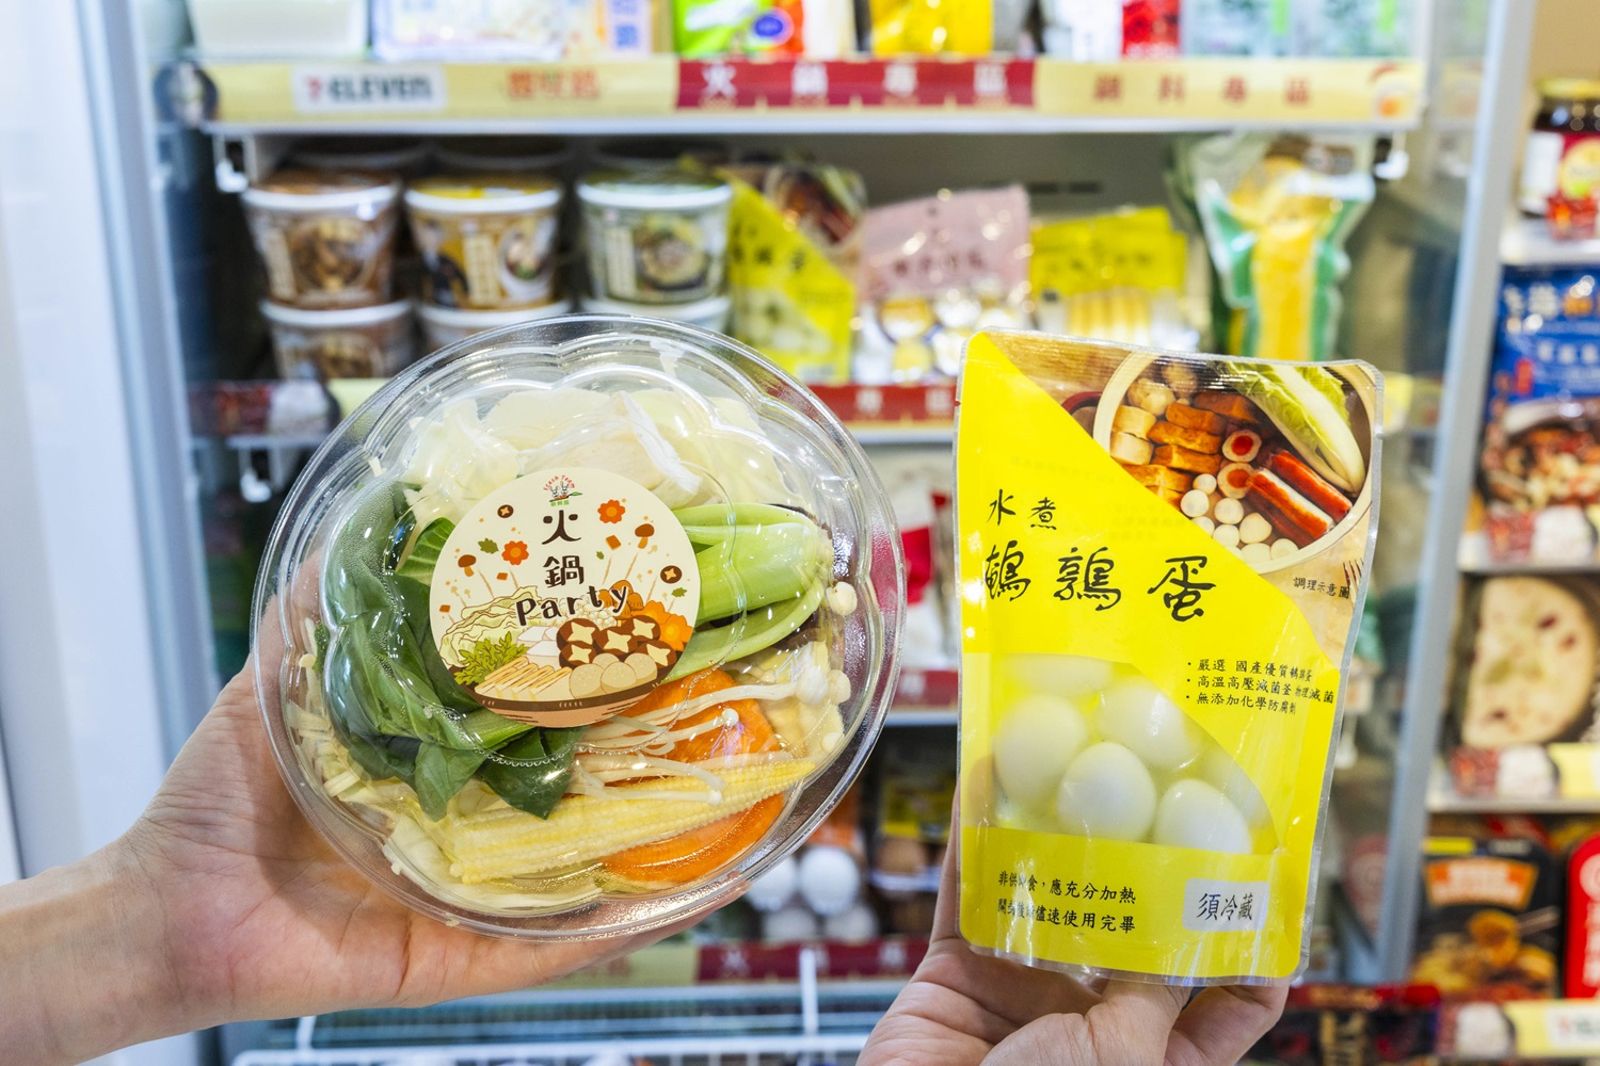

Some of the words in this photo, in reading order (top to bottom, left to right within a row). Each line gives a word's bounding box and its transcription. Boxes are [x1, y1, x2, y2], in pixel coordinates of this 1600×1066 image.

[986, 488, 1058, 531] 水煮
[541, 509, 585, 588] 火鍋
[984, 539, 1217, 623] 鵪鶉蛋
[1293, 576, 1350, 599] 調理示意圖
[515, 585, 628, 627] Party
[1196, 892, 1254, 921] 須冷藏
